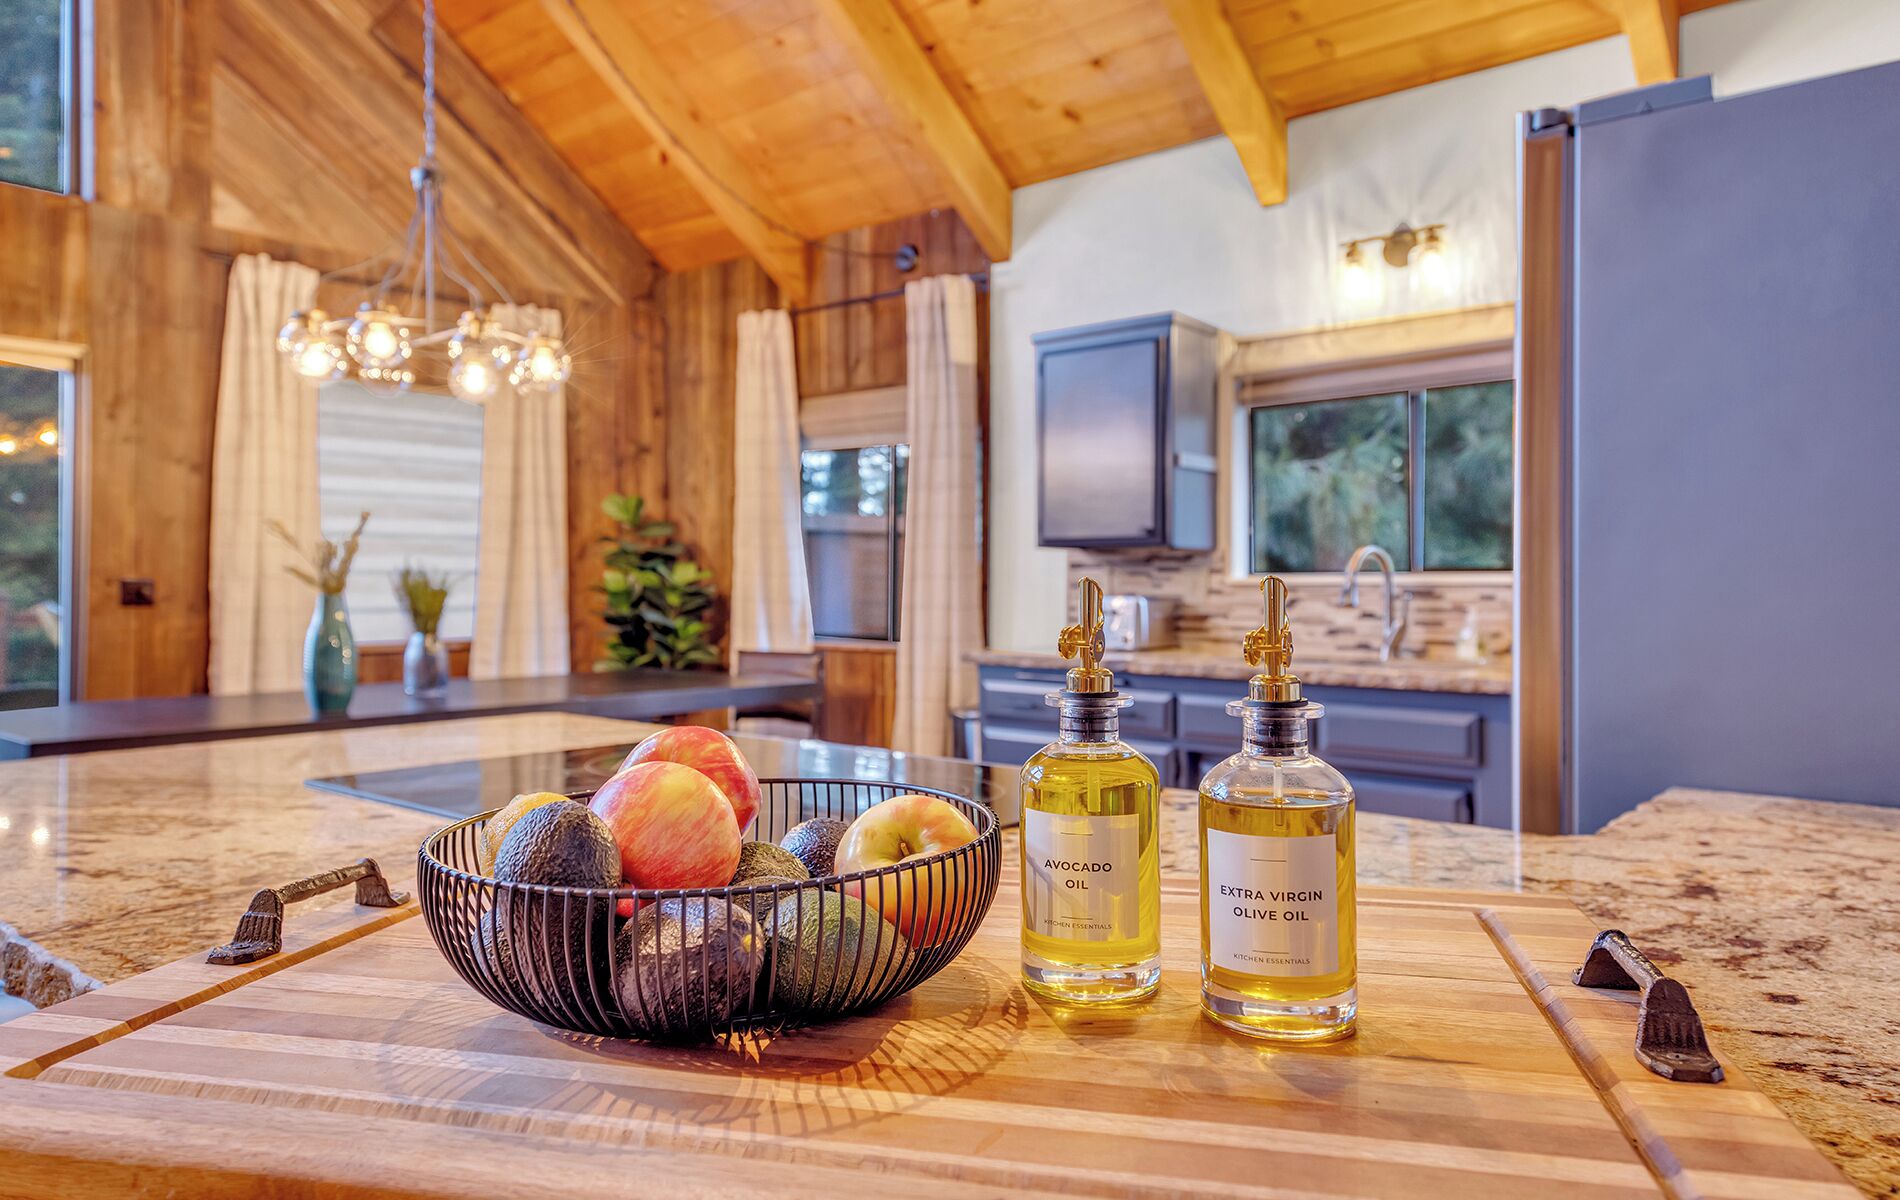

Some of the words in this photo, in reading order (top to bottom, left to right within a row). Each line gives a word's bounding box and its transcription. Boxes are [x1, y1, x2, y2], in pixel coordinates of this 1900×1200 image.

[1044, 859, 1112, 873] AVOCADO
[1065, 879, 1089, 890] OIL
[1220, 885, 1265, 901] EXTRA
[1270, 890, 1323, 902] VIRGIN
[1233, 906, 1277, 921] OLIVE
[1283, 911, 1309, 921] OIL
[1044, 919, 1071, 928] KITCHEN
[1072, 922, 1112, 930] ESSENTIALS
[1233, 953, 1264, 964] KITCHEN
